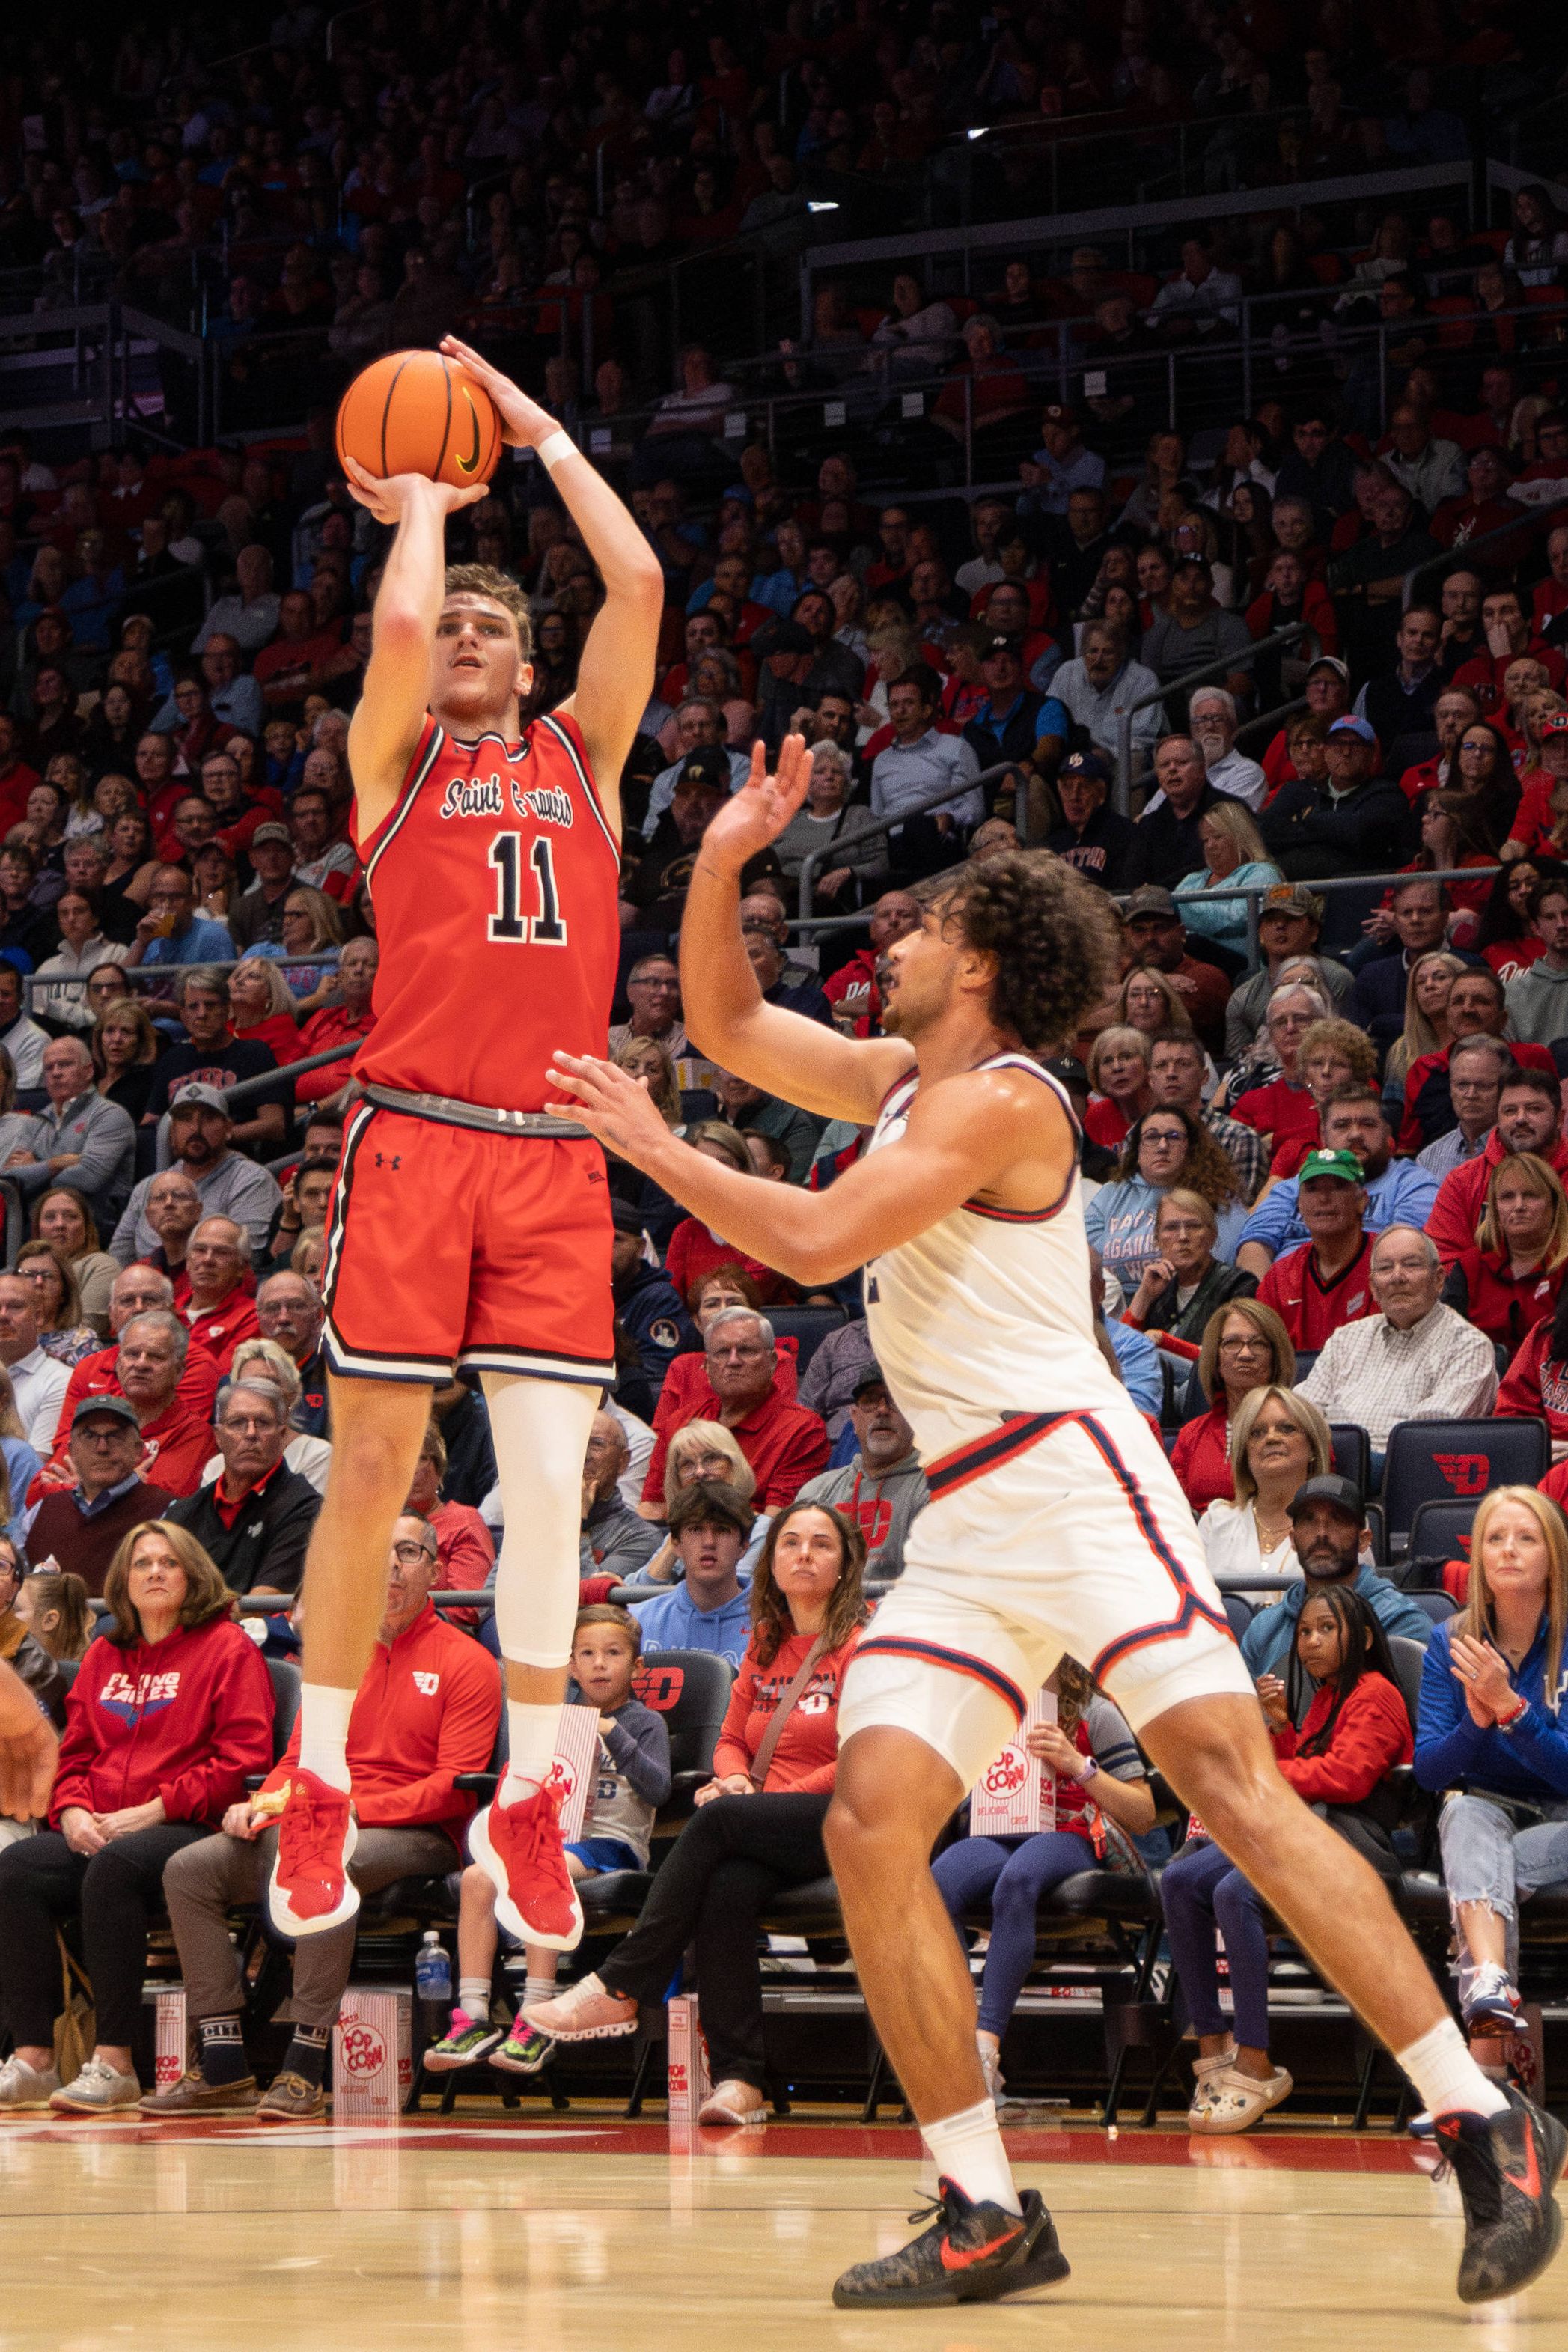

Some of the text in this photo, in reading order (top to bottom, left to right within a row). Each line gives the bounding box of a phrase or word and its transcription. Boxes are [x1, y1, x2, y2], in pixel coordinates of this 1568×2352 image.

[440, 773, 504, 819] Saint
[487, 831, 568, 946] 11
[988, 1752, 1014, 1775] OP
[986, 1764, 1024, 1791] CORN
[344, 2029, 373, 2054] POP
[347, 2044, 382, 2071] CORN
